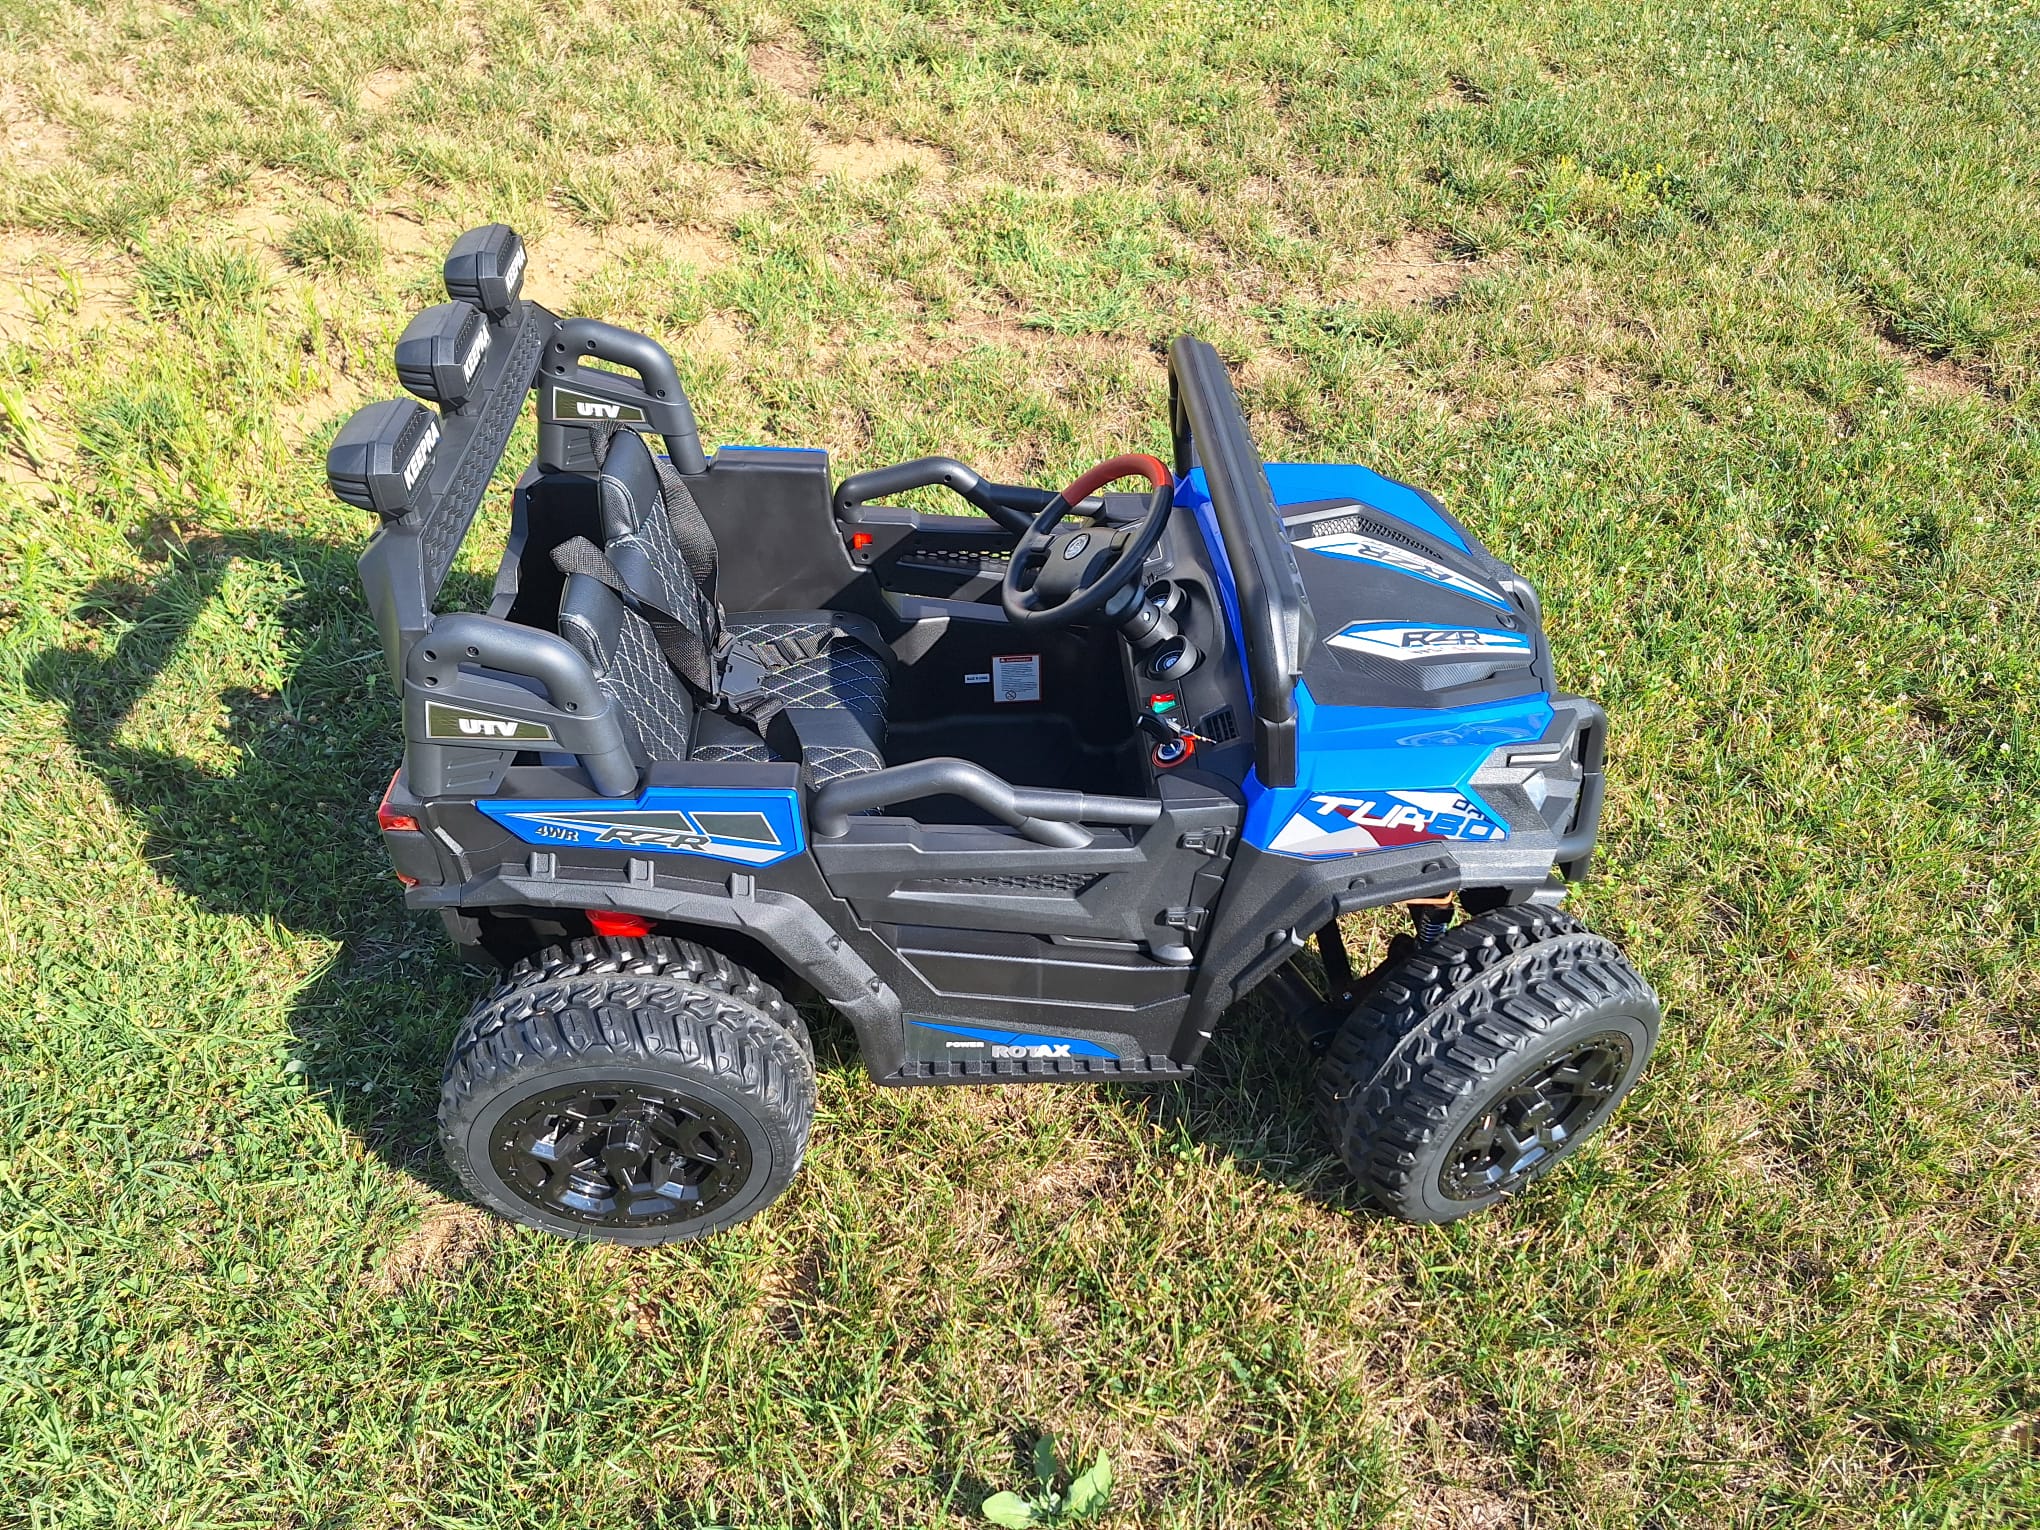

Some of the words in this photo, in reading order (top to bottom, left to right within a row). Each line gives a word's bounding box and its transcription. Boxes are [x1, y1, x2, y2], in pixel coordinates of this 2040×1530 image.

[576, 401, 620, 418] UTV
[403, 421, 440, 491] KEEPRA
[1401, 630, 1484, 648] RZR
[458, 718, 518, 737] UTV
[535, 825, 580, 842] 4WR
[594, 826, 712, 853] RZR
[945, 1041, 984, 1049] POWER
[991, 1044, 1072, 1059] ROTAX
